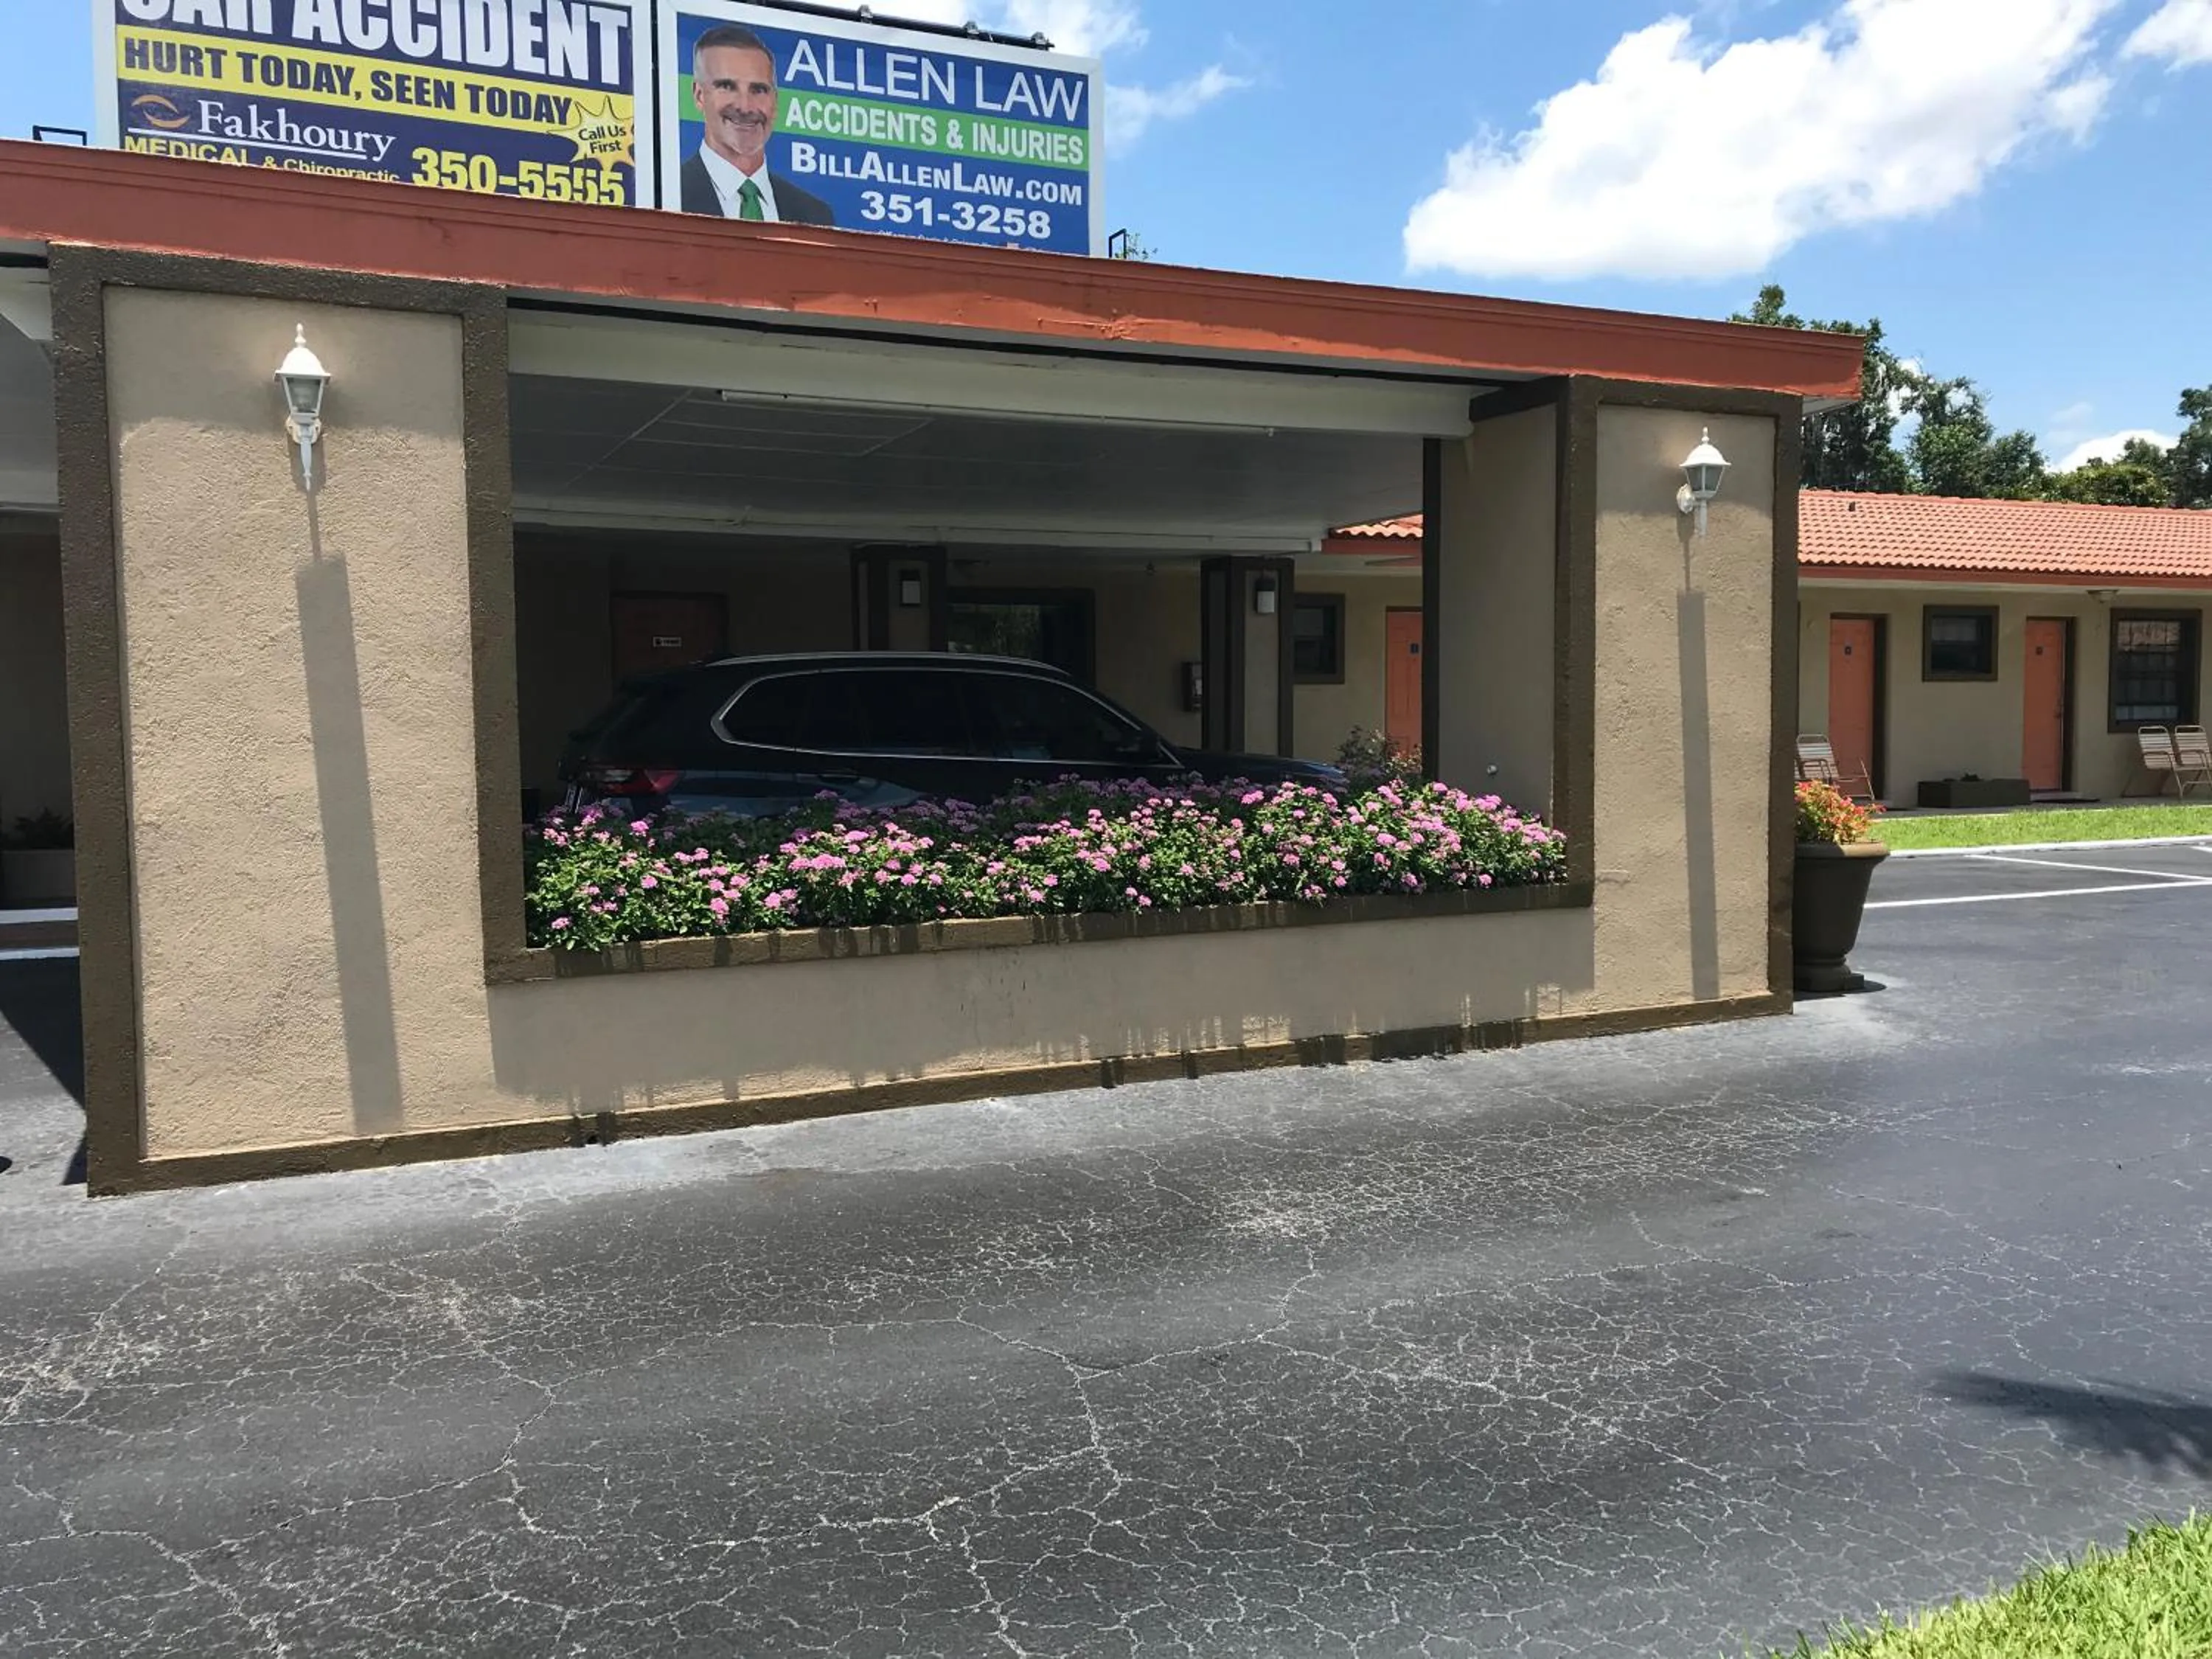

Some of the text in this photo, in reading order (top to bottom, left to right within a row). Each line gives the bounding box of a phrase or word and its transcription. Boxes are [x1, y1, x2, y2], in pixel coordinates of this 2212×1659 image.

[125, 38, 572, 125] HURT TODAY, SEEN TODAY
[785, 39, 1084, 121] ALLEN LAW
[125, 136, 248, 165] MEDICAL
[262, 156, 277, 170] &
[198, 100, 396, 161] Fakhoury
[578, 124, 627, 141] Call Us
[590, 139, 622, 153] First
[785, 98, 1083, 165] ACCIDENTS & INJURIES
[412, 147, 625, 206] 350-5555
[860, 190, 1051, 240] 351-3258
